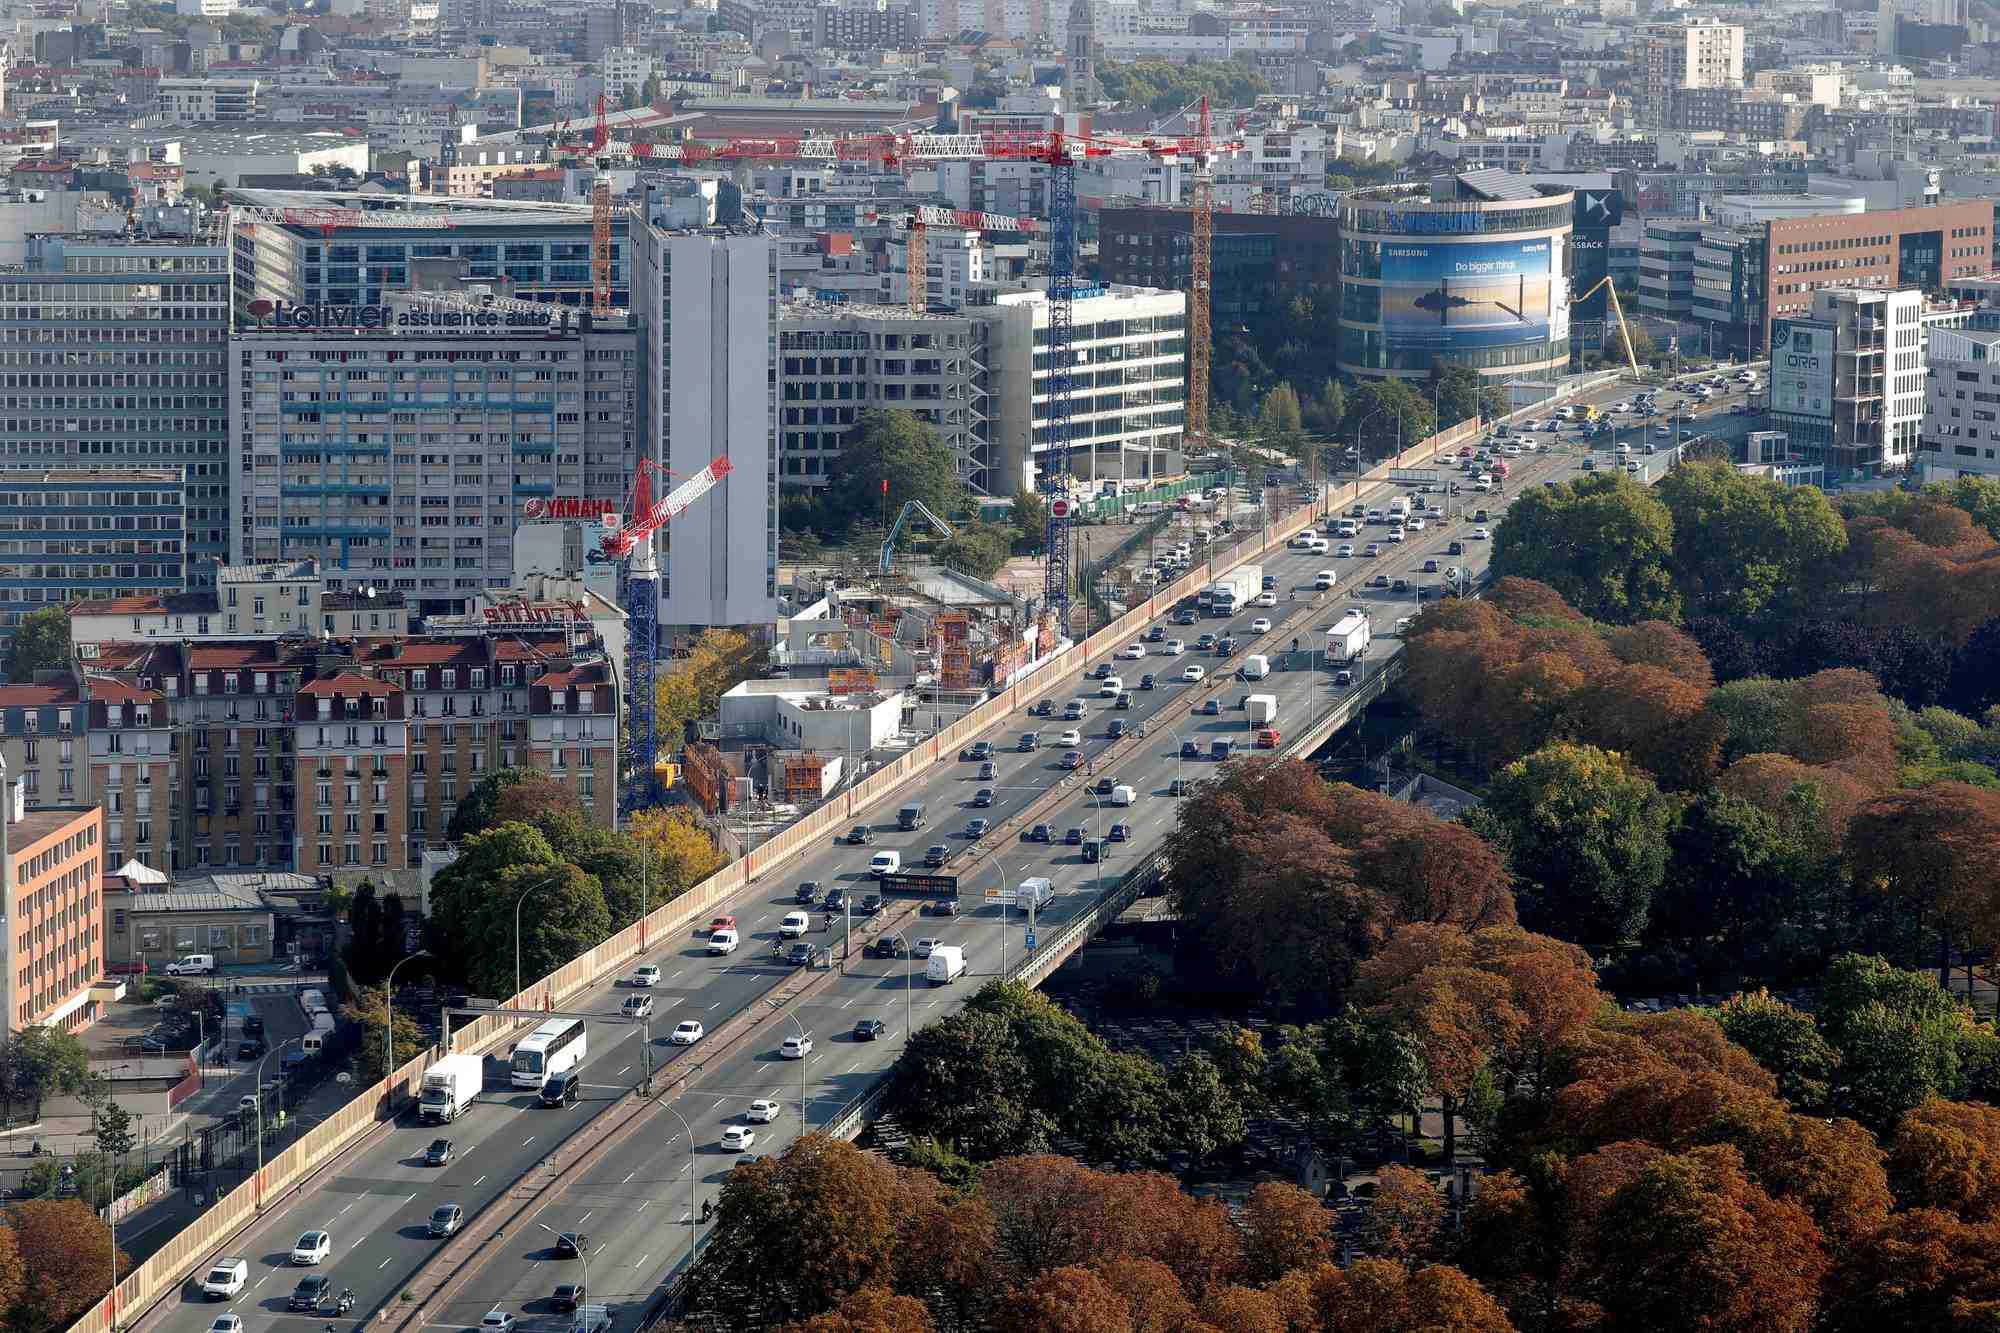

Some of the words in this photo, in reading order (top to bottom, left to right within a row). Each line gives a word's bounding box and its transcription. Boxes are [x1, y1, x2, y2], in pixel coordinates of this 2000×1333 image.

[275, 299, 392, 327] L'olivier
[398, 311, 498, 327] assurance
[505, 310, 551, 327] auto
[546, 497, 615, 518] YAMAHA
